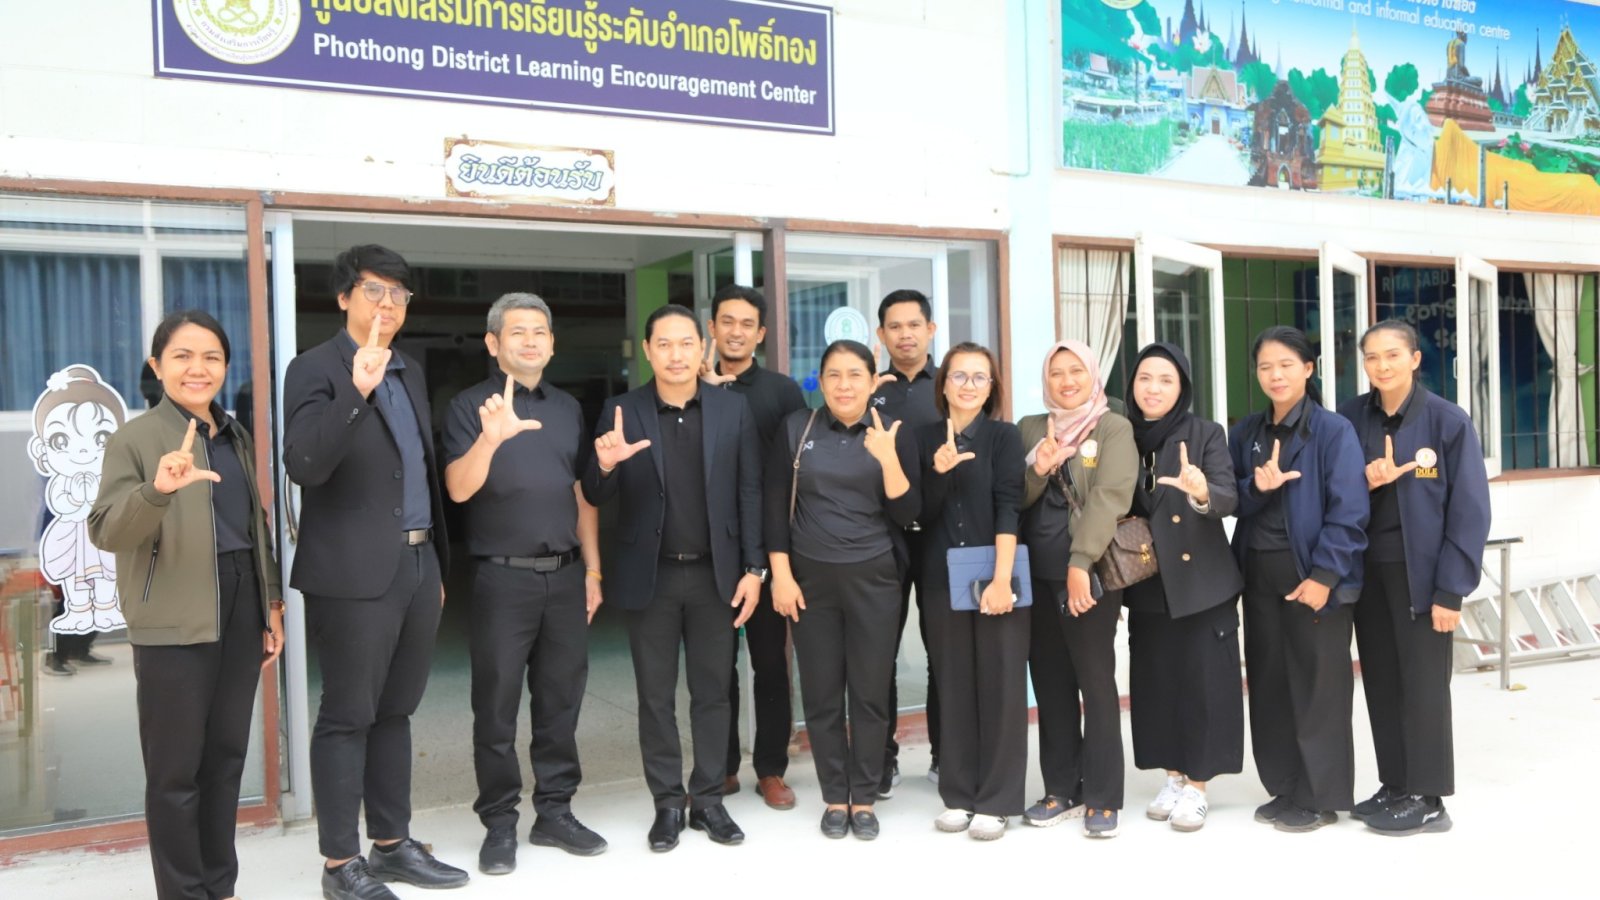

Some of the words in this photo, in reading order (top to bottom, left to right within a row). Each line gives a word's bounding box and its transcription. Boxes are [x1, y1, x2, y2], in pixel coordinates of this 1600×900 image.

[1376, 2, 1420, 25] informal
[1424, 10, 1476, 34] education
[1479, 23, 1511, 40] centre
[314, 32, 425, 71] Phothong
[431, 45, 510, 75] District
[516, 54, 604, 87] Learning
[611, 65, 757, 98] Encouragement
[761, 81, 817, 105] Center
[458, 153, 604, 191] ยินดีต้อนรับ
[1415, 467, 1437, 478] DOLE
